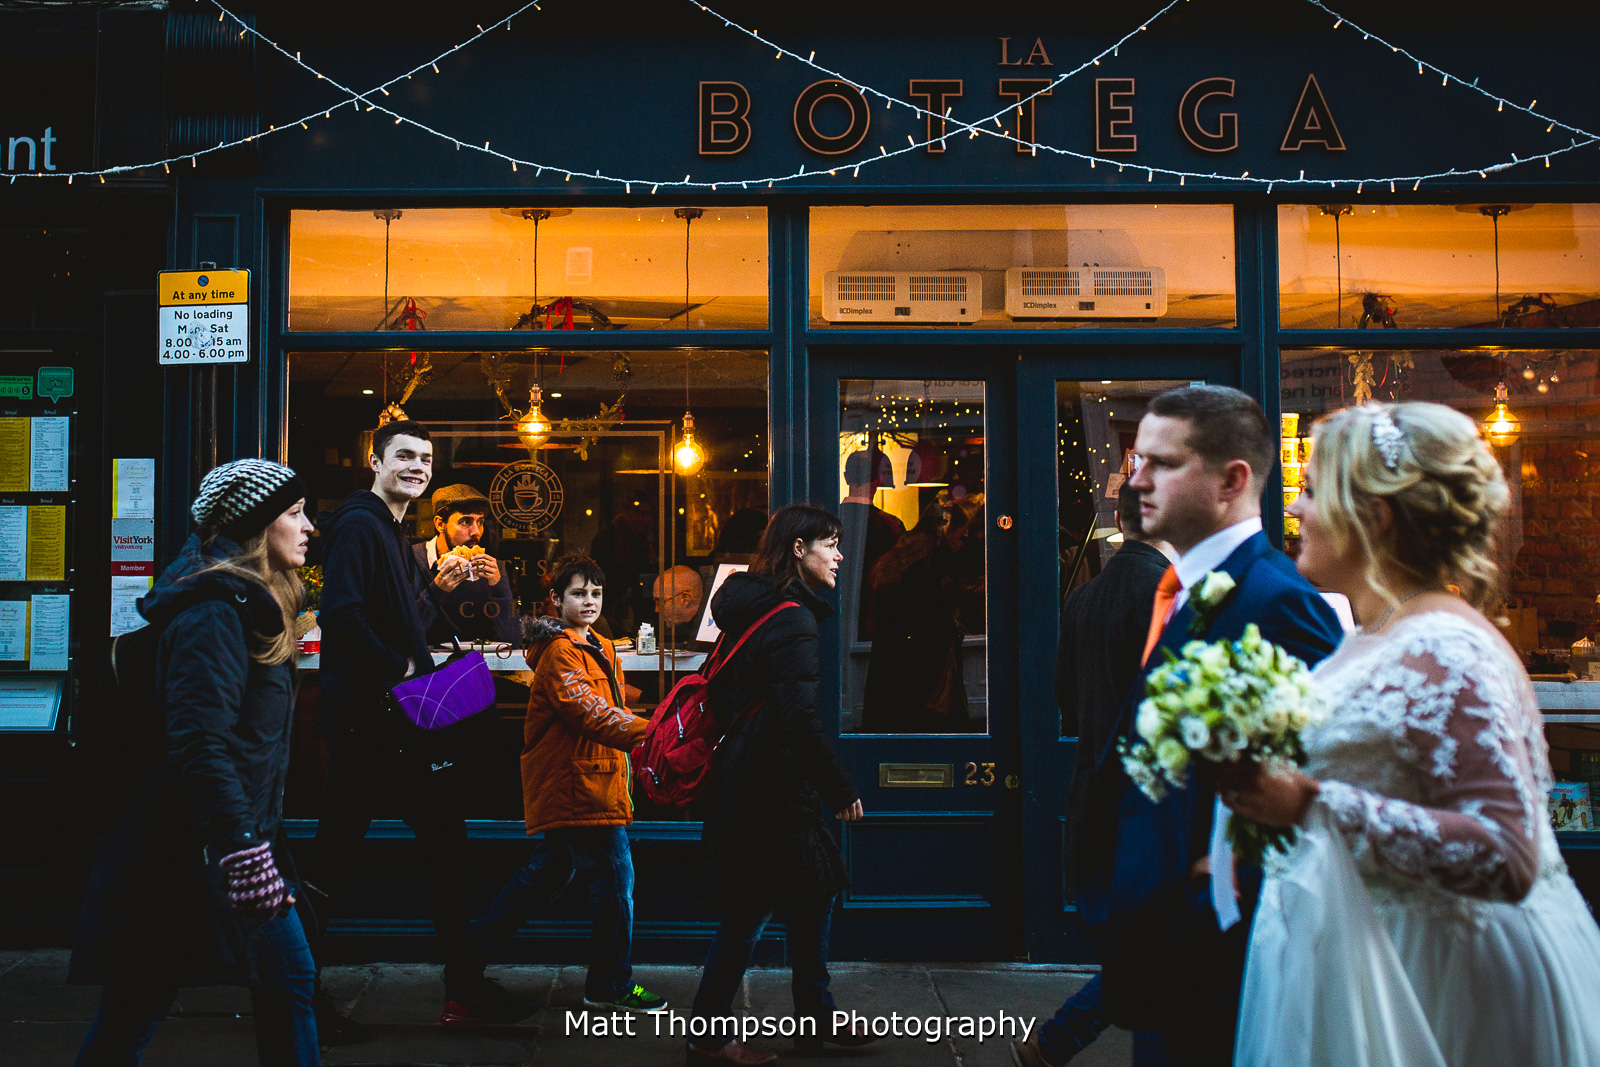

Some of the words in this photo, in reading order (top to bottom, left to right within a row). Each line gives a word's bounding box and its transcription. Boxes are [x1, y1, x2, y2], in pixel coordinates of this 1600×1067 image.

[998, 37, 1053, 66] LA
[699, 73, 1347, 155] BOTTEGA
[0, 126, 57, 170] nt
[172, 291, 185, 300] At
[188, 292, 207, 301] any
[211, 290, 235, 298] time
[174, 311, 190, 320] No
[193, 309, 233, 320] loading
[178, 325, 201, 334] Mn
[210, 324, 229, 333] Sat
[165, 338, 192, 348] 8.00
[226, 338, 242, 346] am
[163, 350, 190, 359] 4.00
[199, 349, 225, 358] 6.00
[228, 350, 244, 359] pm
[503, 469, 514, 478] LA
[514, 464, 550, 479] BOTTEGA
[113, 536, 153, 544] VisitYork
[452, 560, 548, 576] ARTIS
[964, 761, 996, 787] 23
